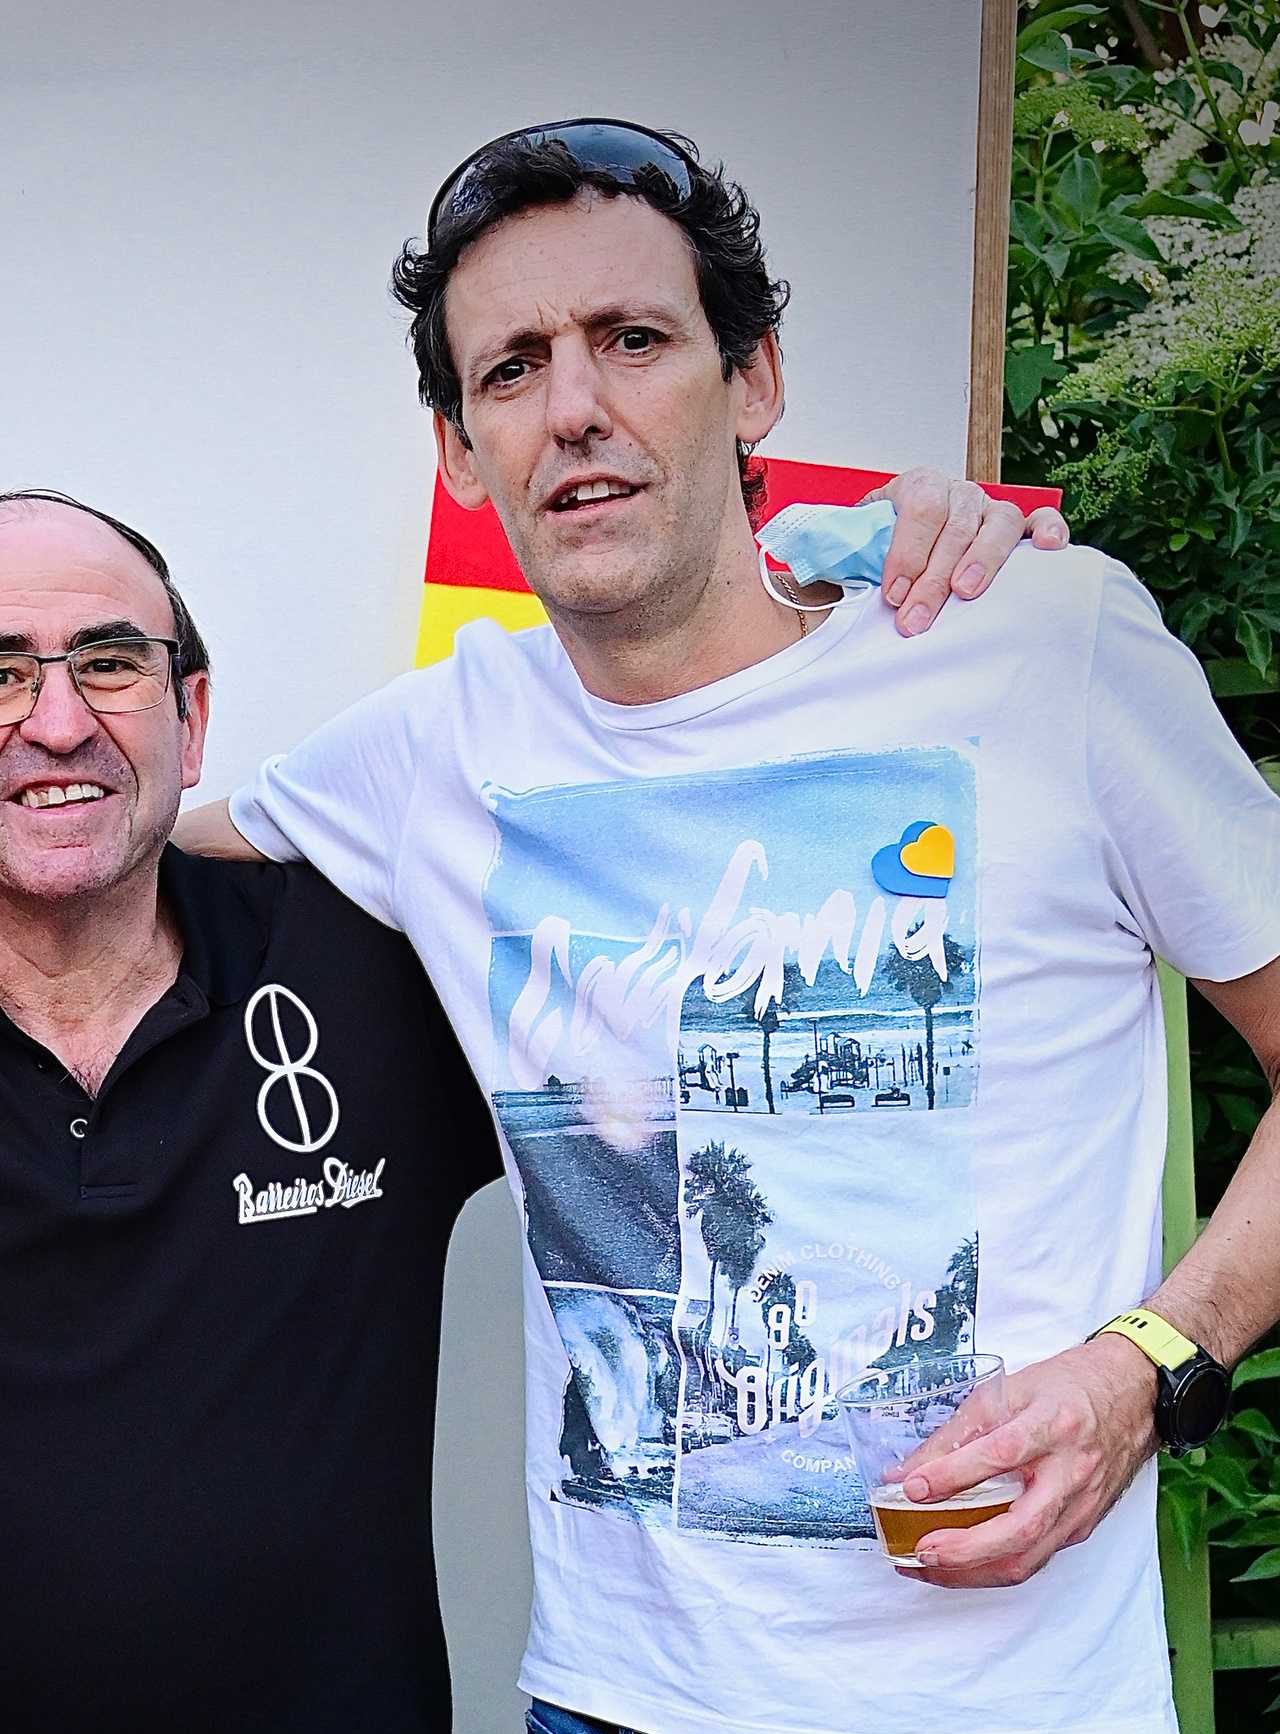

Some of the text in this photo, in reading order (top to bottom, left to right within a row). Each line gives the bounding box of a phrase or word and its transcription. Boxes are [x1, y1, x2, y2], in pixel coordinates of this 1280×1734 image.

[232, 1156, 386, 1225] Barreiros Diesel
[800, 1242, 902, 1291] CLOTHING
[714, 1281, 938, 1440] Originals
[781, 1448, 857, 1474] COMPAN
